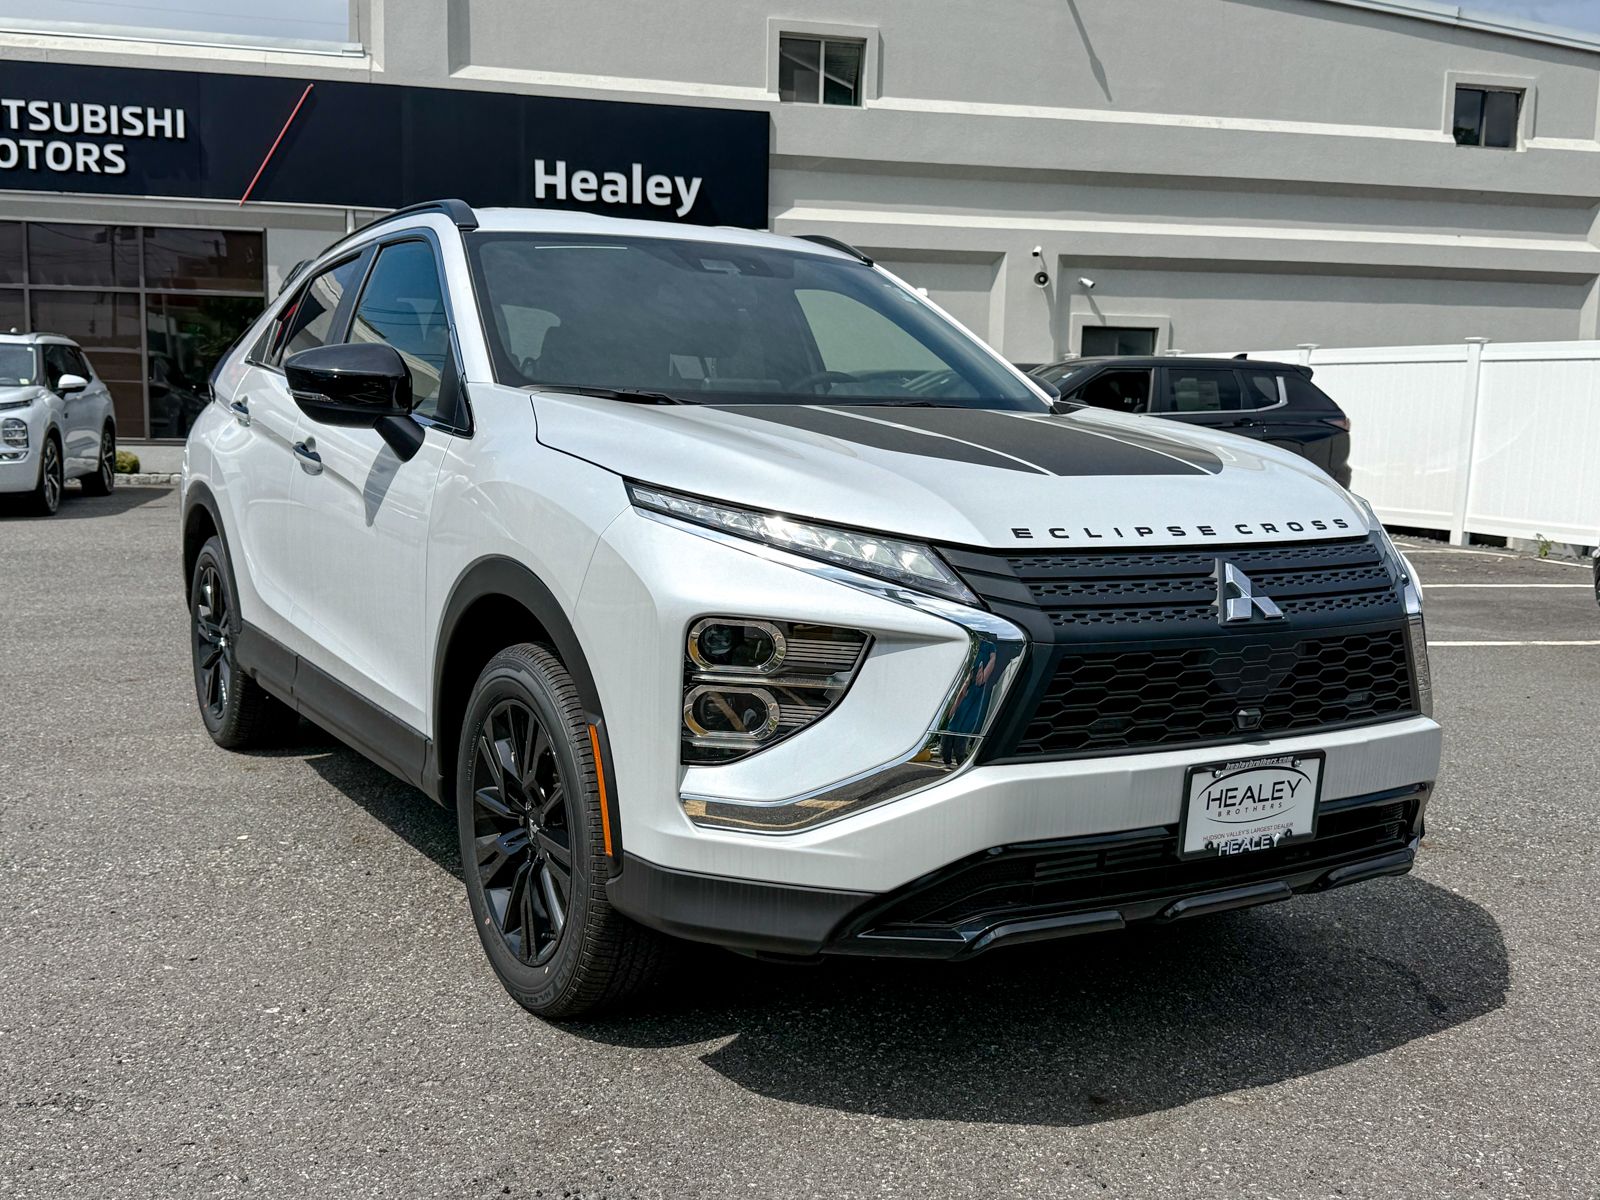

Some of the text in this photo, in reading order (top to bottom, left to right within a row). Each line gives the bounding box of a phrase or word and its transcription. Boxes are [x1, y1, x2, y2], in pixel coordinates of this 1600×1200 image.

[534, 159, 702, 218] Healey
[1011, 518, 1350, 540] ECLIPSE CROSS
[1225, 755, 1294, 770] healeybrothers.com
[1206, 778, 1302, 811] HEALEY
[1217, 802, 1283, 818] BROTHERS
[1202, 822, 1294, 842] HUDSON VALLEY'S LARGEST DEALER
[1218, 832, 1280, 856] HEALEY
